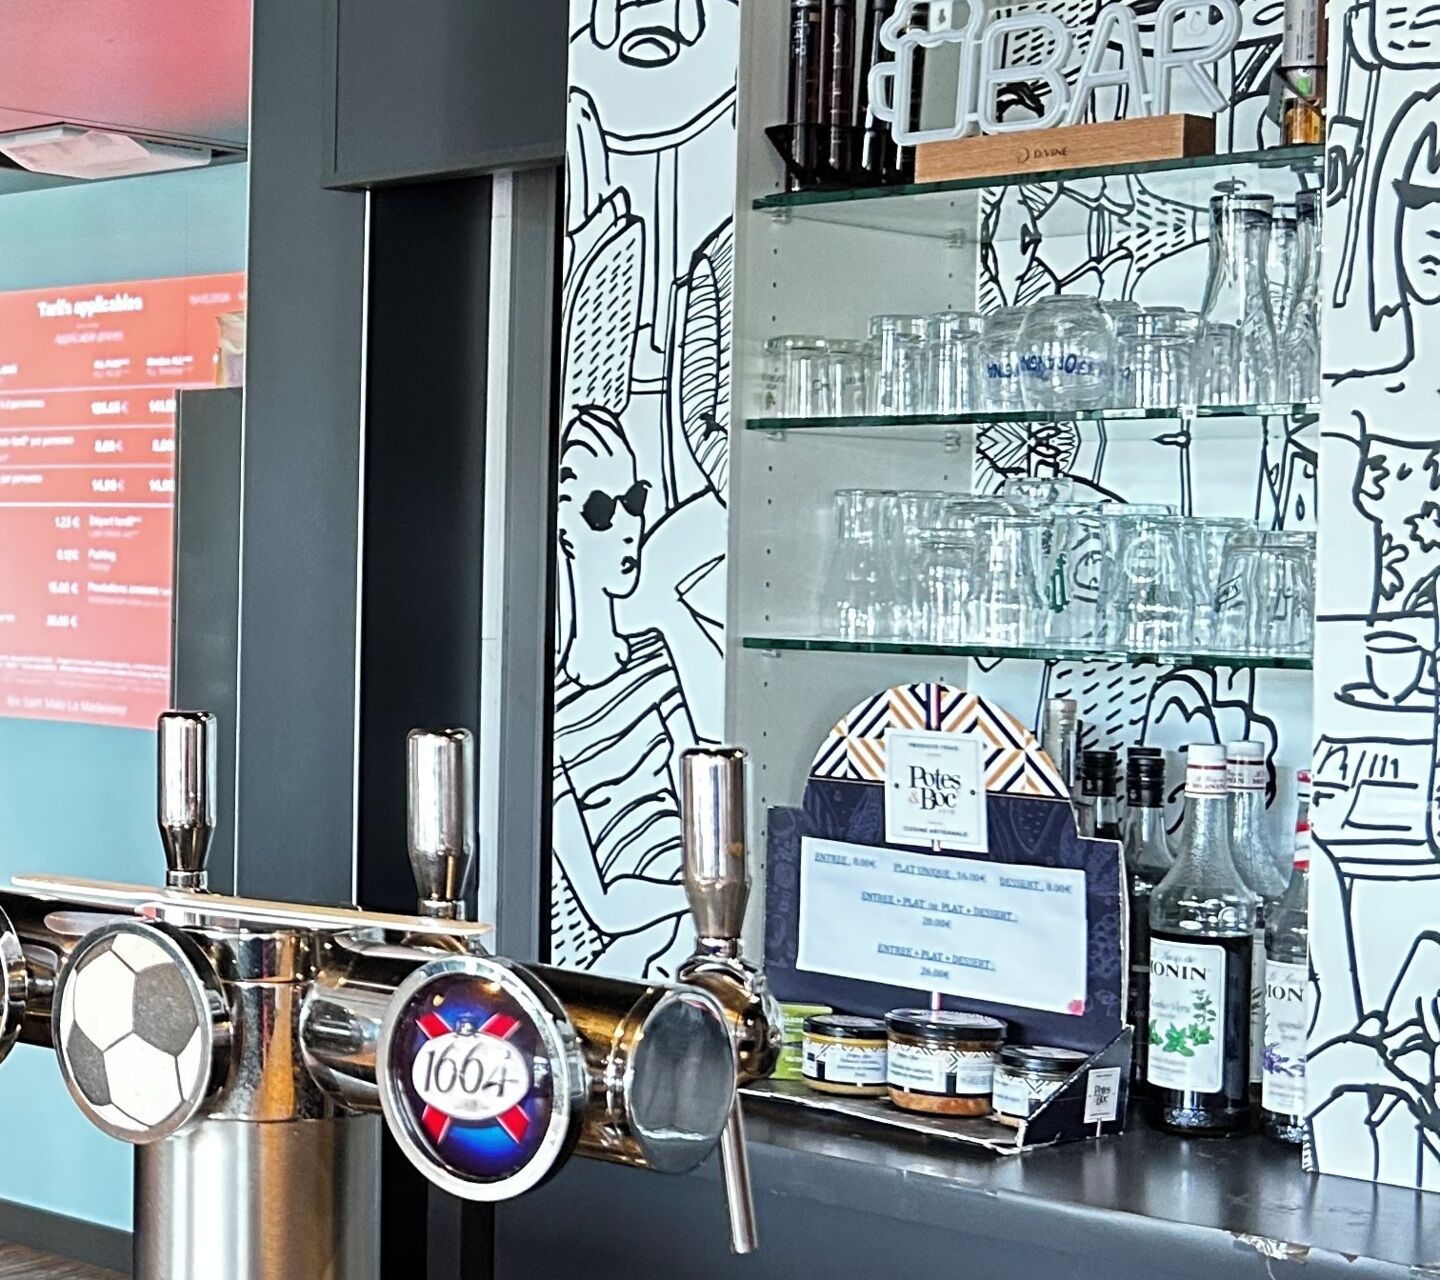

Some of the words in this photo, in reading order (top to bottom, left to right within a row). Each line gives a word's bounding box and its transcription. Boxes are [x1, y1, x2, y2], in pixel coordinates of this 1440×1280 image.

[908, 765, 961, 790] Potes
[920, 787, 957, 810] Boc
[423, 1041, 520, 1098] 1664
